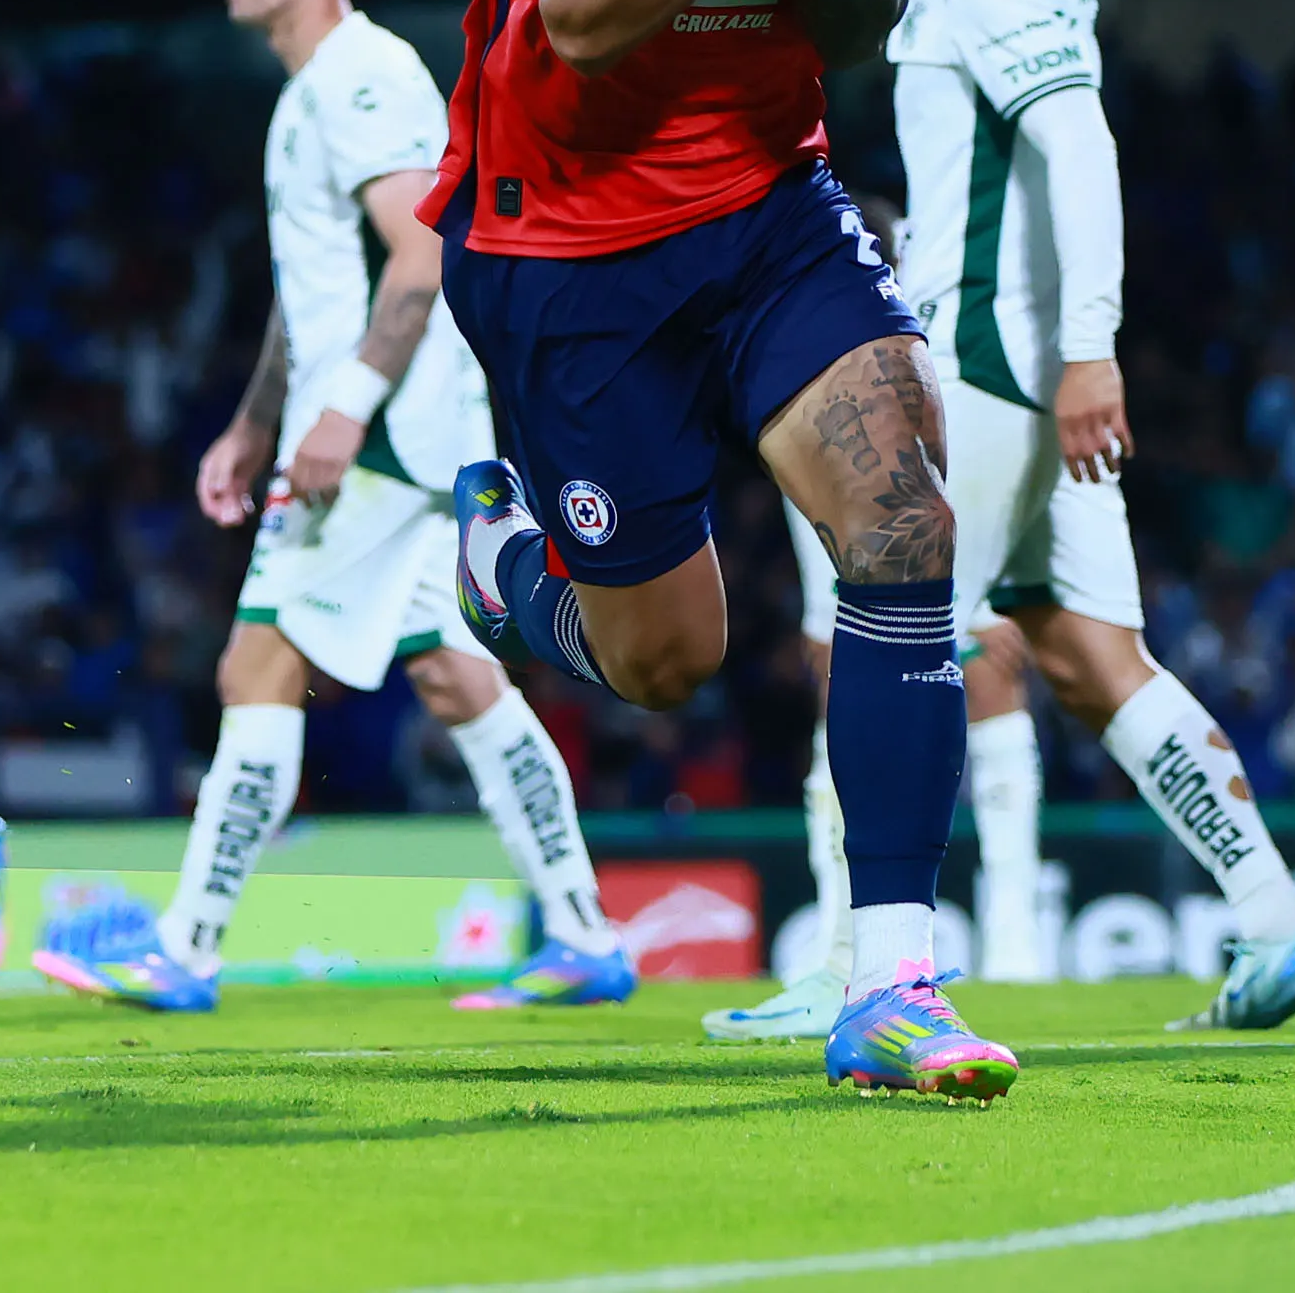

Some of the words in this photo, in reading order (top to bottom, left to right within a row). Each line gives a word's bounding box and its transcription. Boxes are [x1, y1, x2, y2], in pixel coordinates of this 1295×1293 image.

[673, 13, 724, 33] CRUZ
[725, 12, 774, 30] AZUL
[1147, 732, 1257, 872] PERDURA
